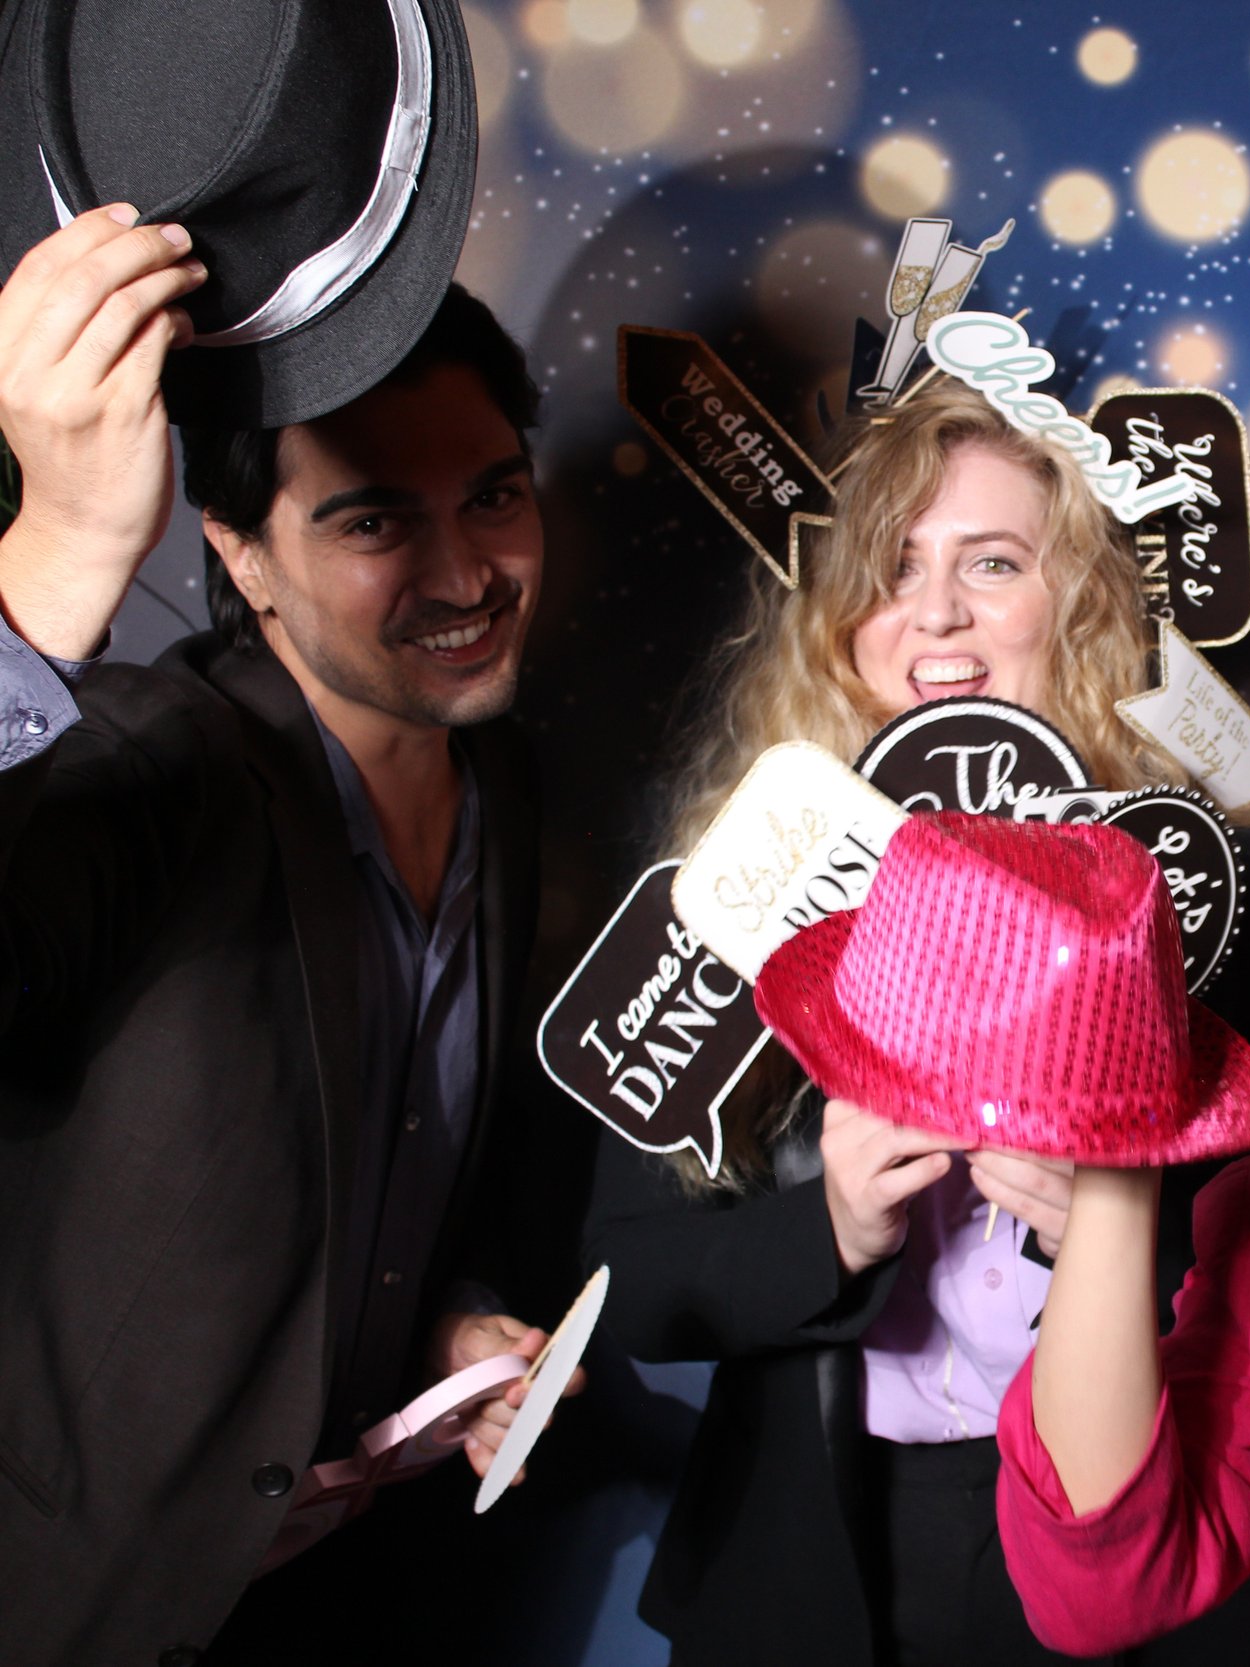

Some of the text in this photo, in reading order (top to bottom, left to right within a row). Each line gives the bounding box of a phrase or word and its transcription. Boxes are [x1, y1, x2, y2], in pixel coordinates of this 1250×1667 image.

[662, 395, 765, 507] Crasher
[681, 362, 803, 506] Wedding
[935, 320, 1187, 514] Cheers!
[1126, 412, 1173, 480] the
[1168, 697, 1241, 781] Party!
[1186, 670, 1249, 750] Life of the
[925, 741, 1051, 815] The
[714, 808, 828, 932] Strike
[580, 1019, 624, 1077] I
[617, 954, 681, 1041] came
[610, 952, 743, 1122] DANC
